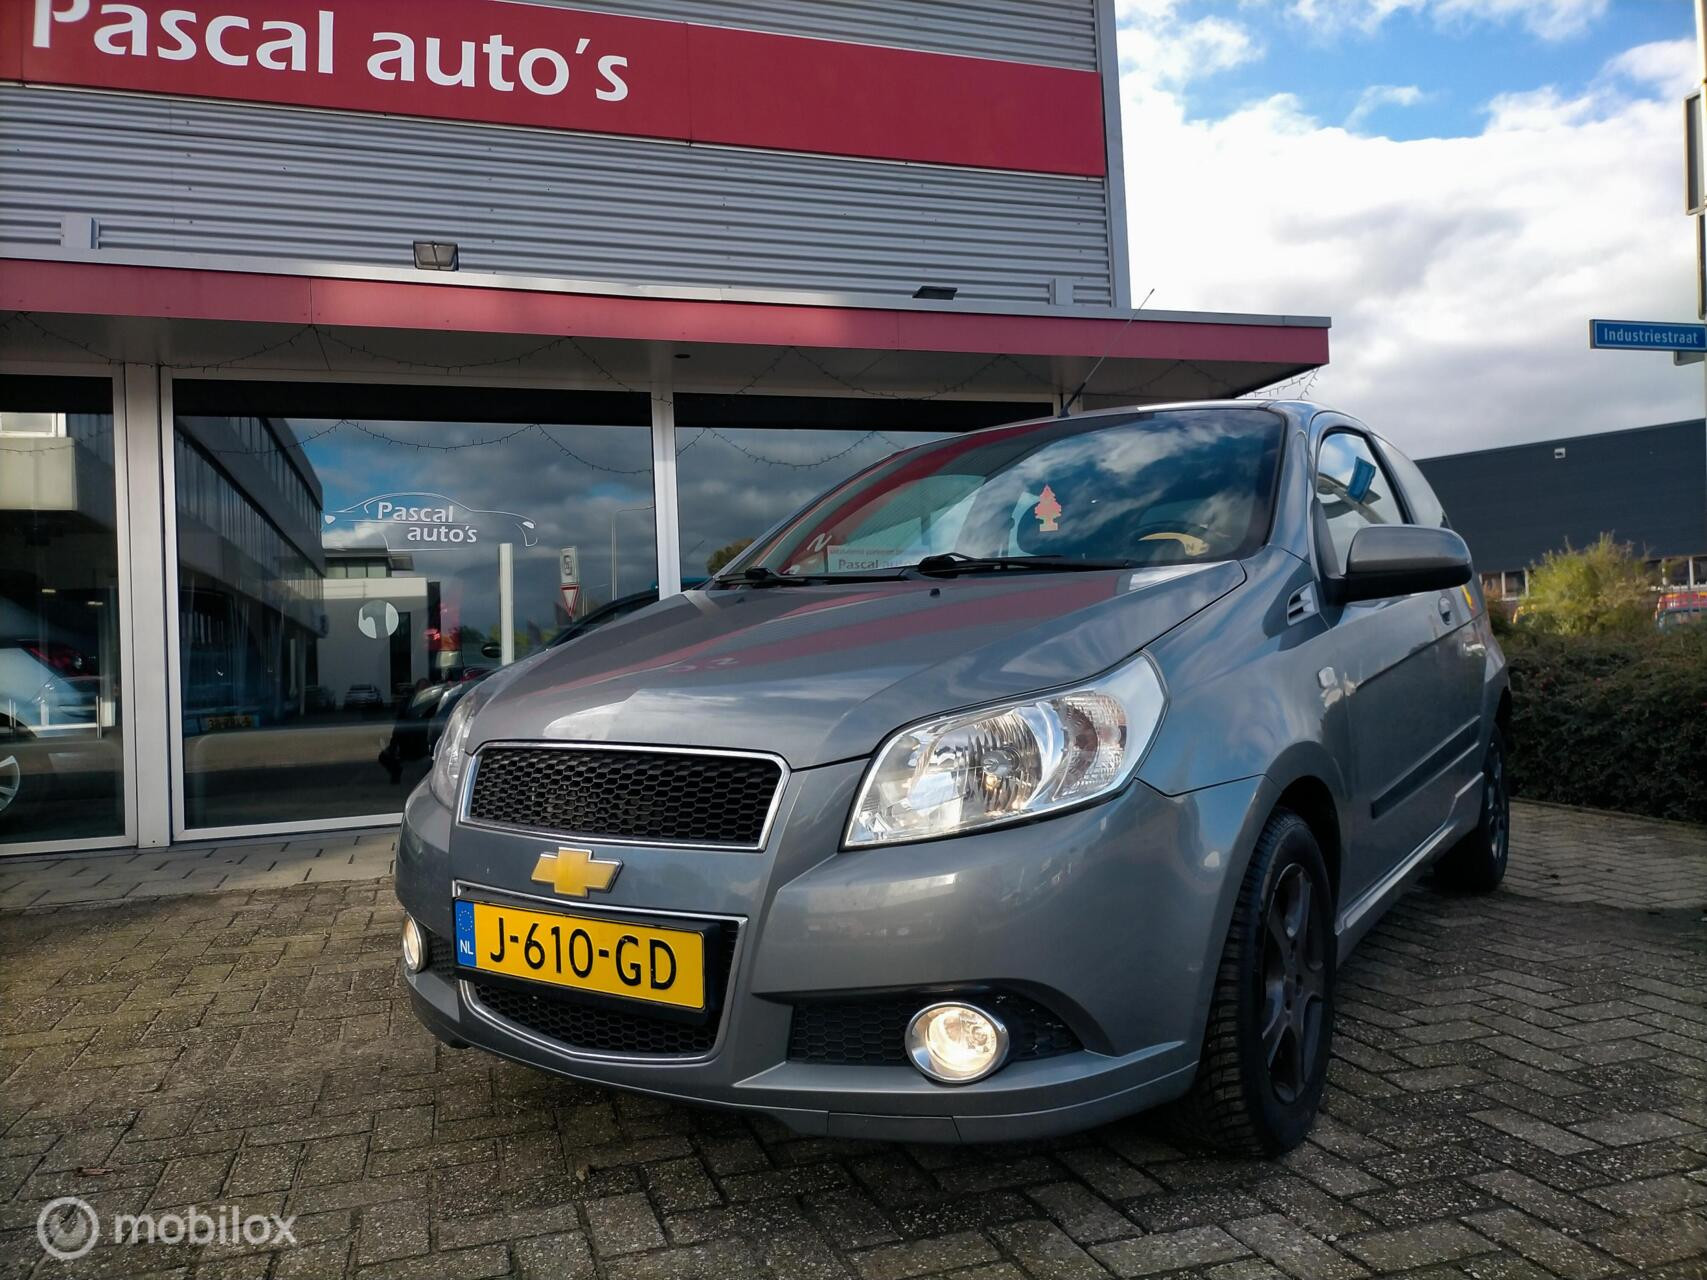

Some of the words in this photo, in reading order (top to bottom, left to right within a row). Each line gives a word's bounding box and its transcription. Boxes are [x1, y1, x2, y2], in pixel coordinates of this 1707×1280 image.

[33, 0, 334, 74] Pascal
[366, 31, 629, 102] auto's
[1604, 327, 1698, 344] Industriestraat
[377, 502, 453, 522] Pascal
[407, 526, 477, 542] auto's
[838, 559, 879, 569] Pascal
[459, 939, 474, 955] NL
[490, 917, 677, 990] J-610-GD
